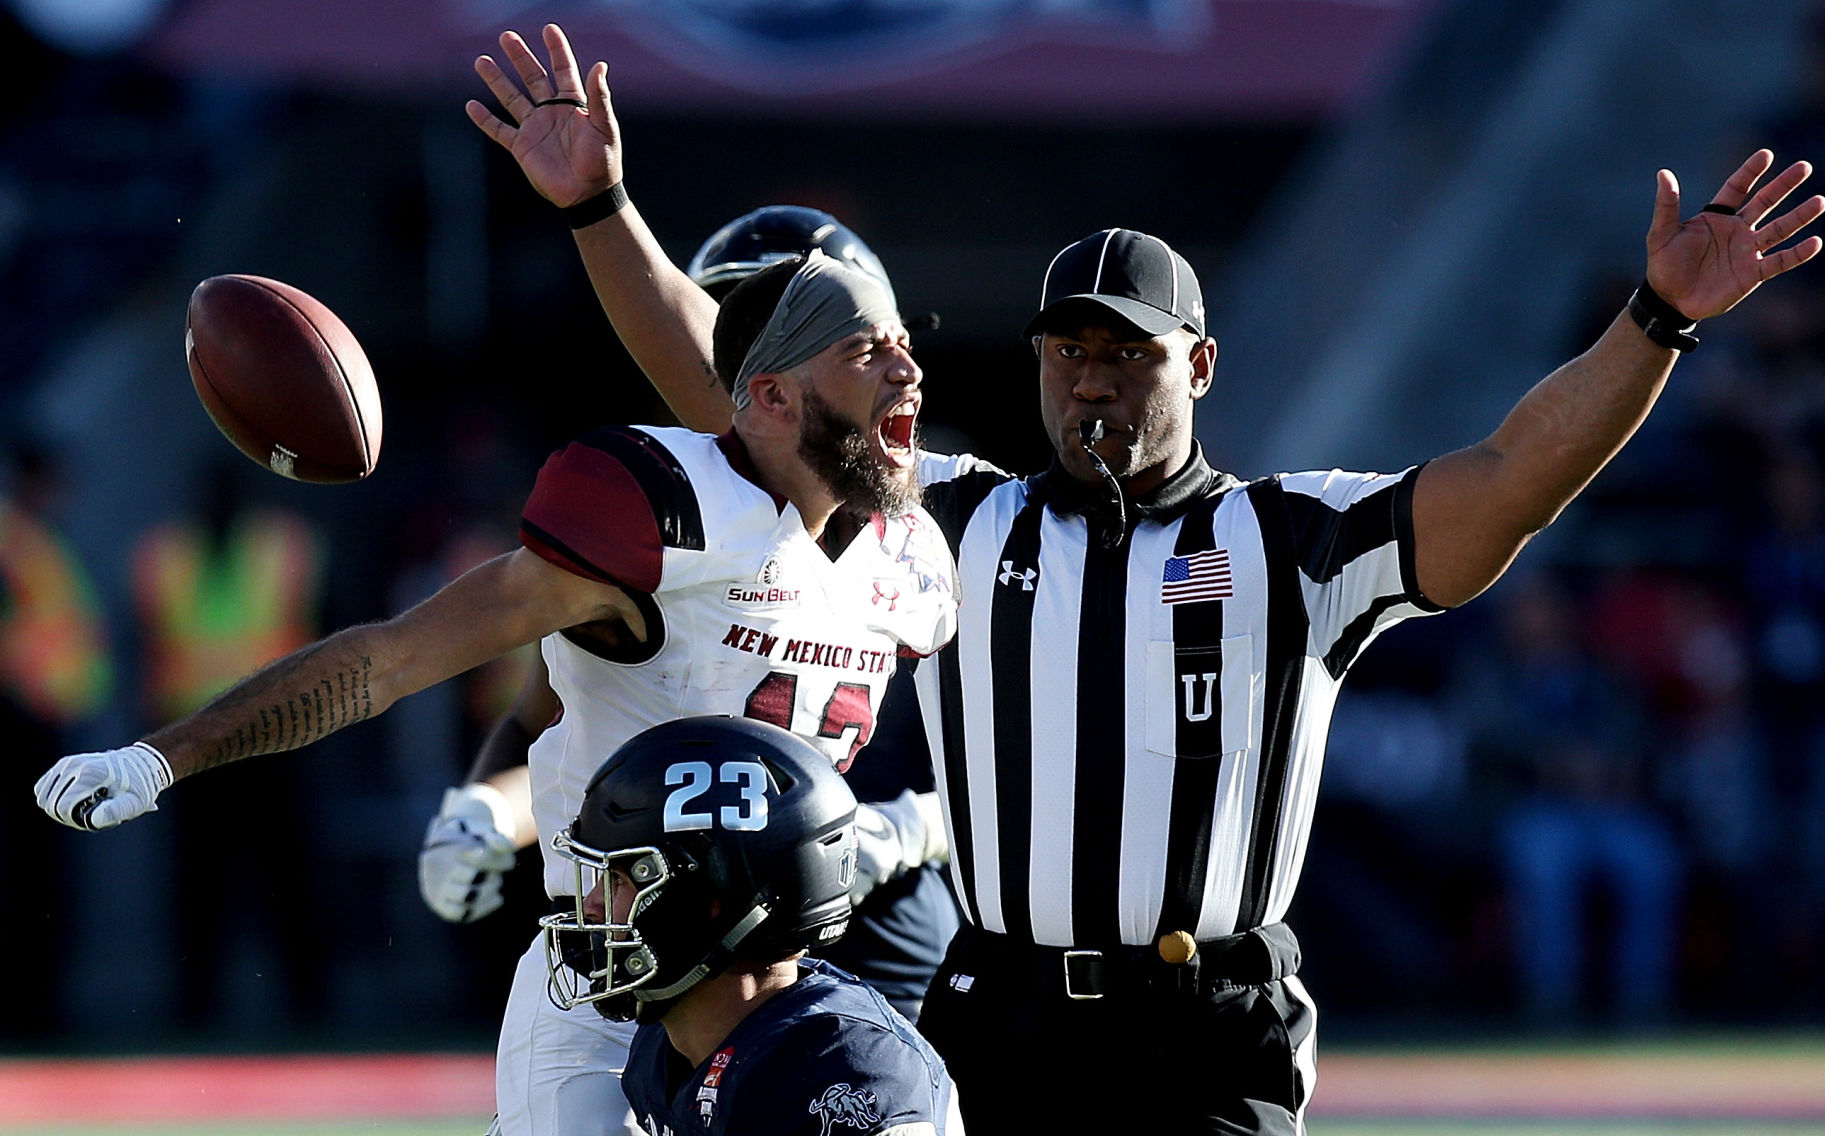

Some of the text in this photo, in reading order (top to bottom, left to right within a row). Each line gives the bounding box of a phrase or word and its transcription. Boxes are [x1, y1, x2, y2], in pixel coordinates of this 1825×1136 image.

[722, 623, 778, 658] NEW
[782, 638, 852, 669] MEXICO
[1181, 672, 1217, 722] U
[663, 760, 769, 832] 23
